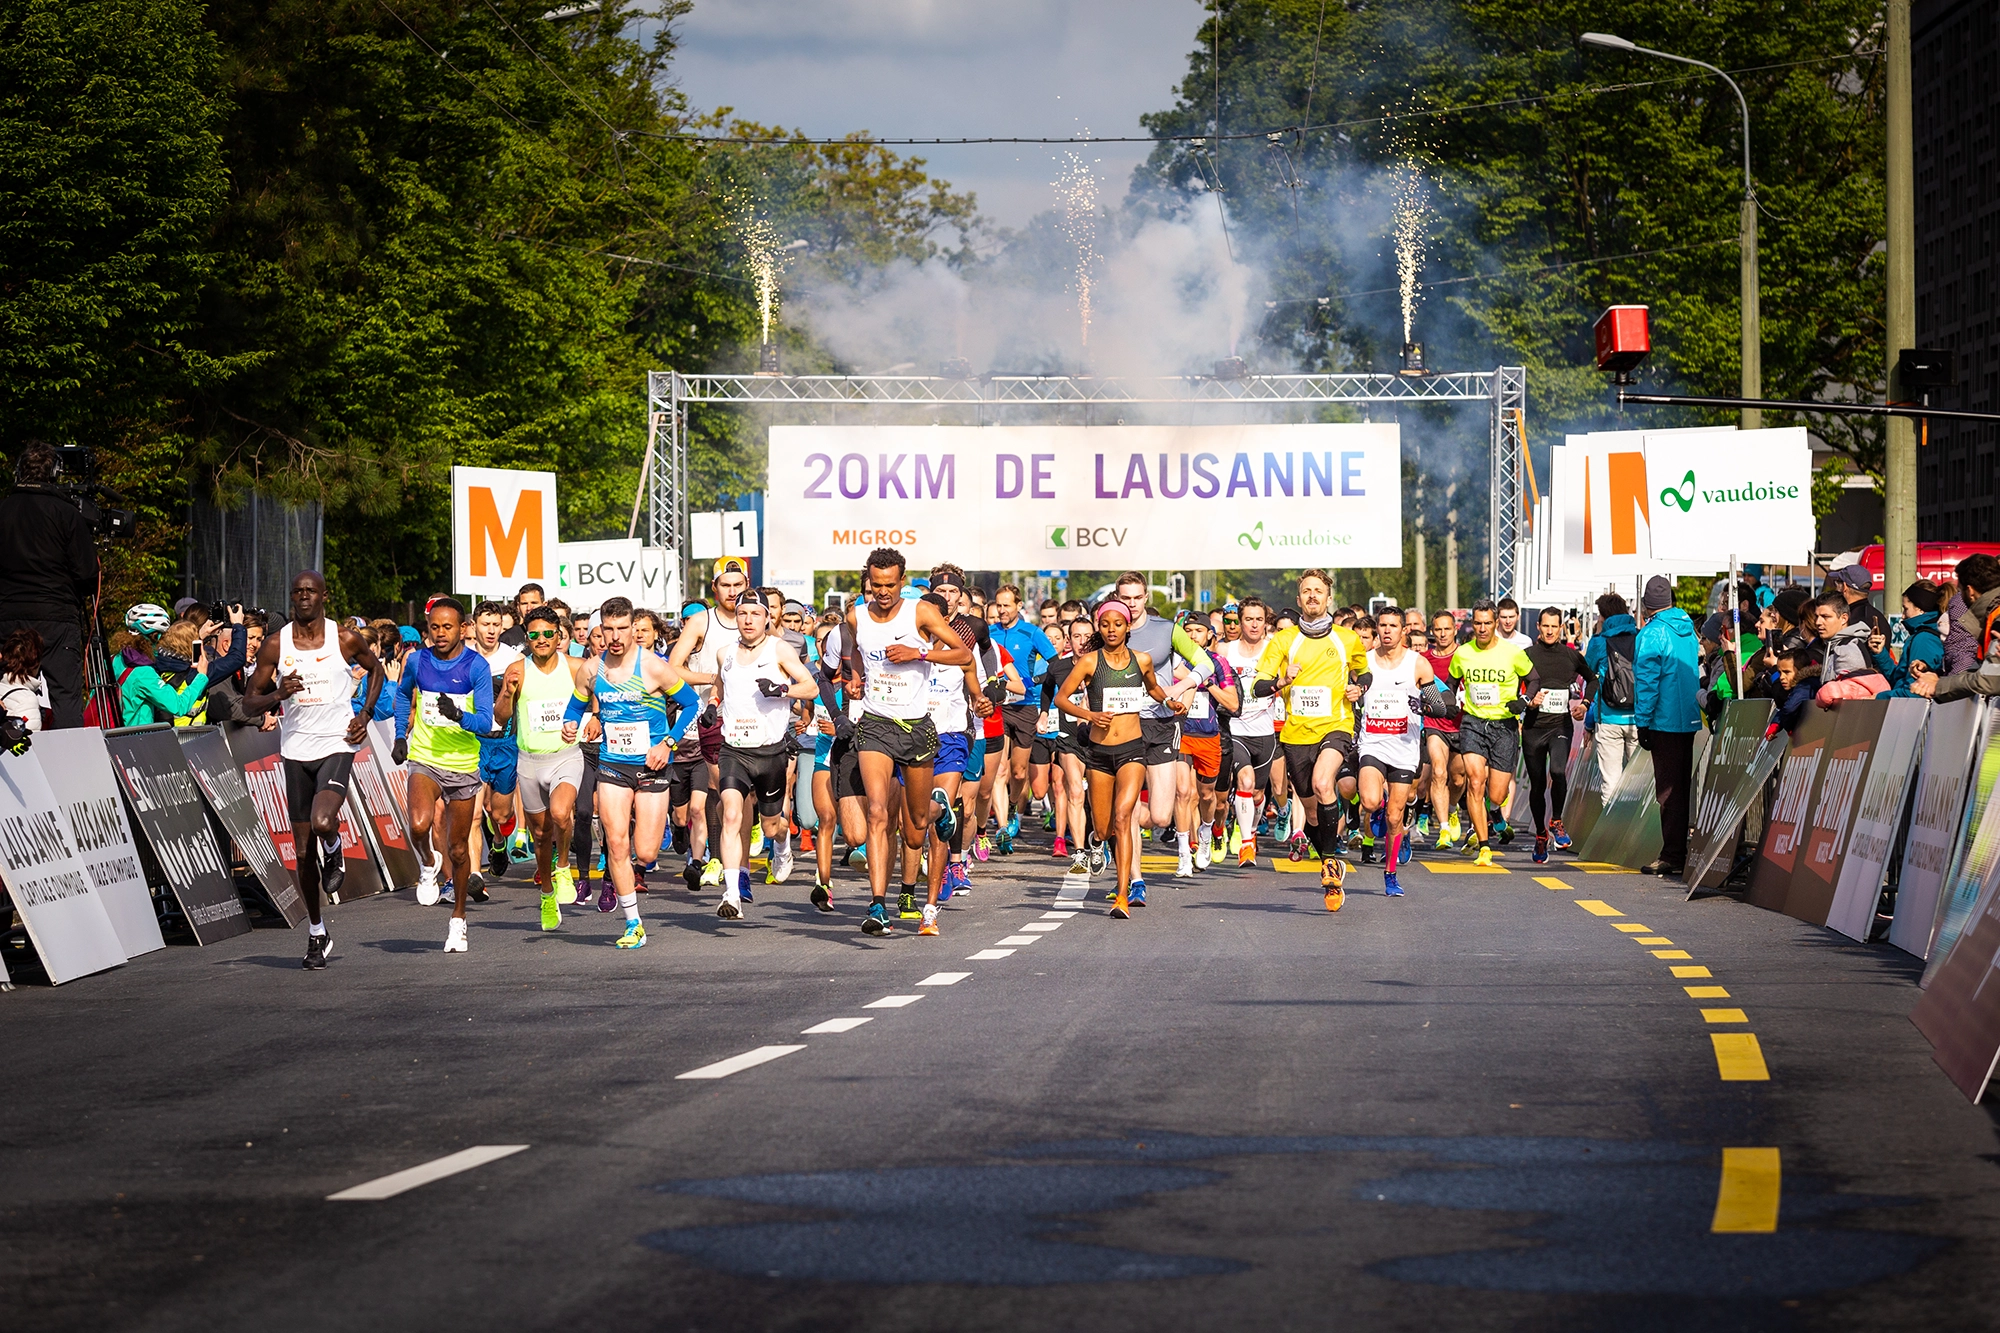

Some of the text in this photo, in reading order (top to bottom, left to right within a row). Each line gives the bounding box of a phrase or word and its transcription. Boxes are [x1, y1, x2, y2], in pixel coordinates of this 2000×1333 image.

[802, 450, 1366, 500] 20KM DE LAUSANNE
[1702, 481, 1799, 504] vaudoise
[468, 486, 544, 580] M
[732, 521, 745, 548] 1
[832, 529, 917, 546] MIGROS
[1075, 527, 1128, 548] BCV
[1267, 528, 1353, 547] vaudoise
[578, 560, 636, 586] BCV
[1466, 668, 1506, 683] ASICS
[887, 686, 892, 694] 3
[541, 714, 561, 722] 1005
[1770, 747, 1824, 852] SPORTXX
[1812, 750, 1868, 862] SPORTXX
[59, 797, 128, 853] AUSANNE
[105, 856, 139, 885] OLYMPIQUE
[19, 870, 89, 908] CAPITALE OLYMPIQUE
